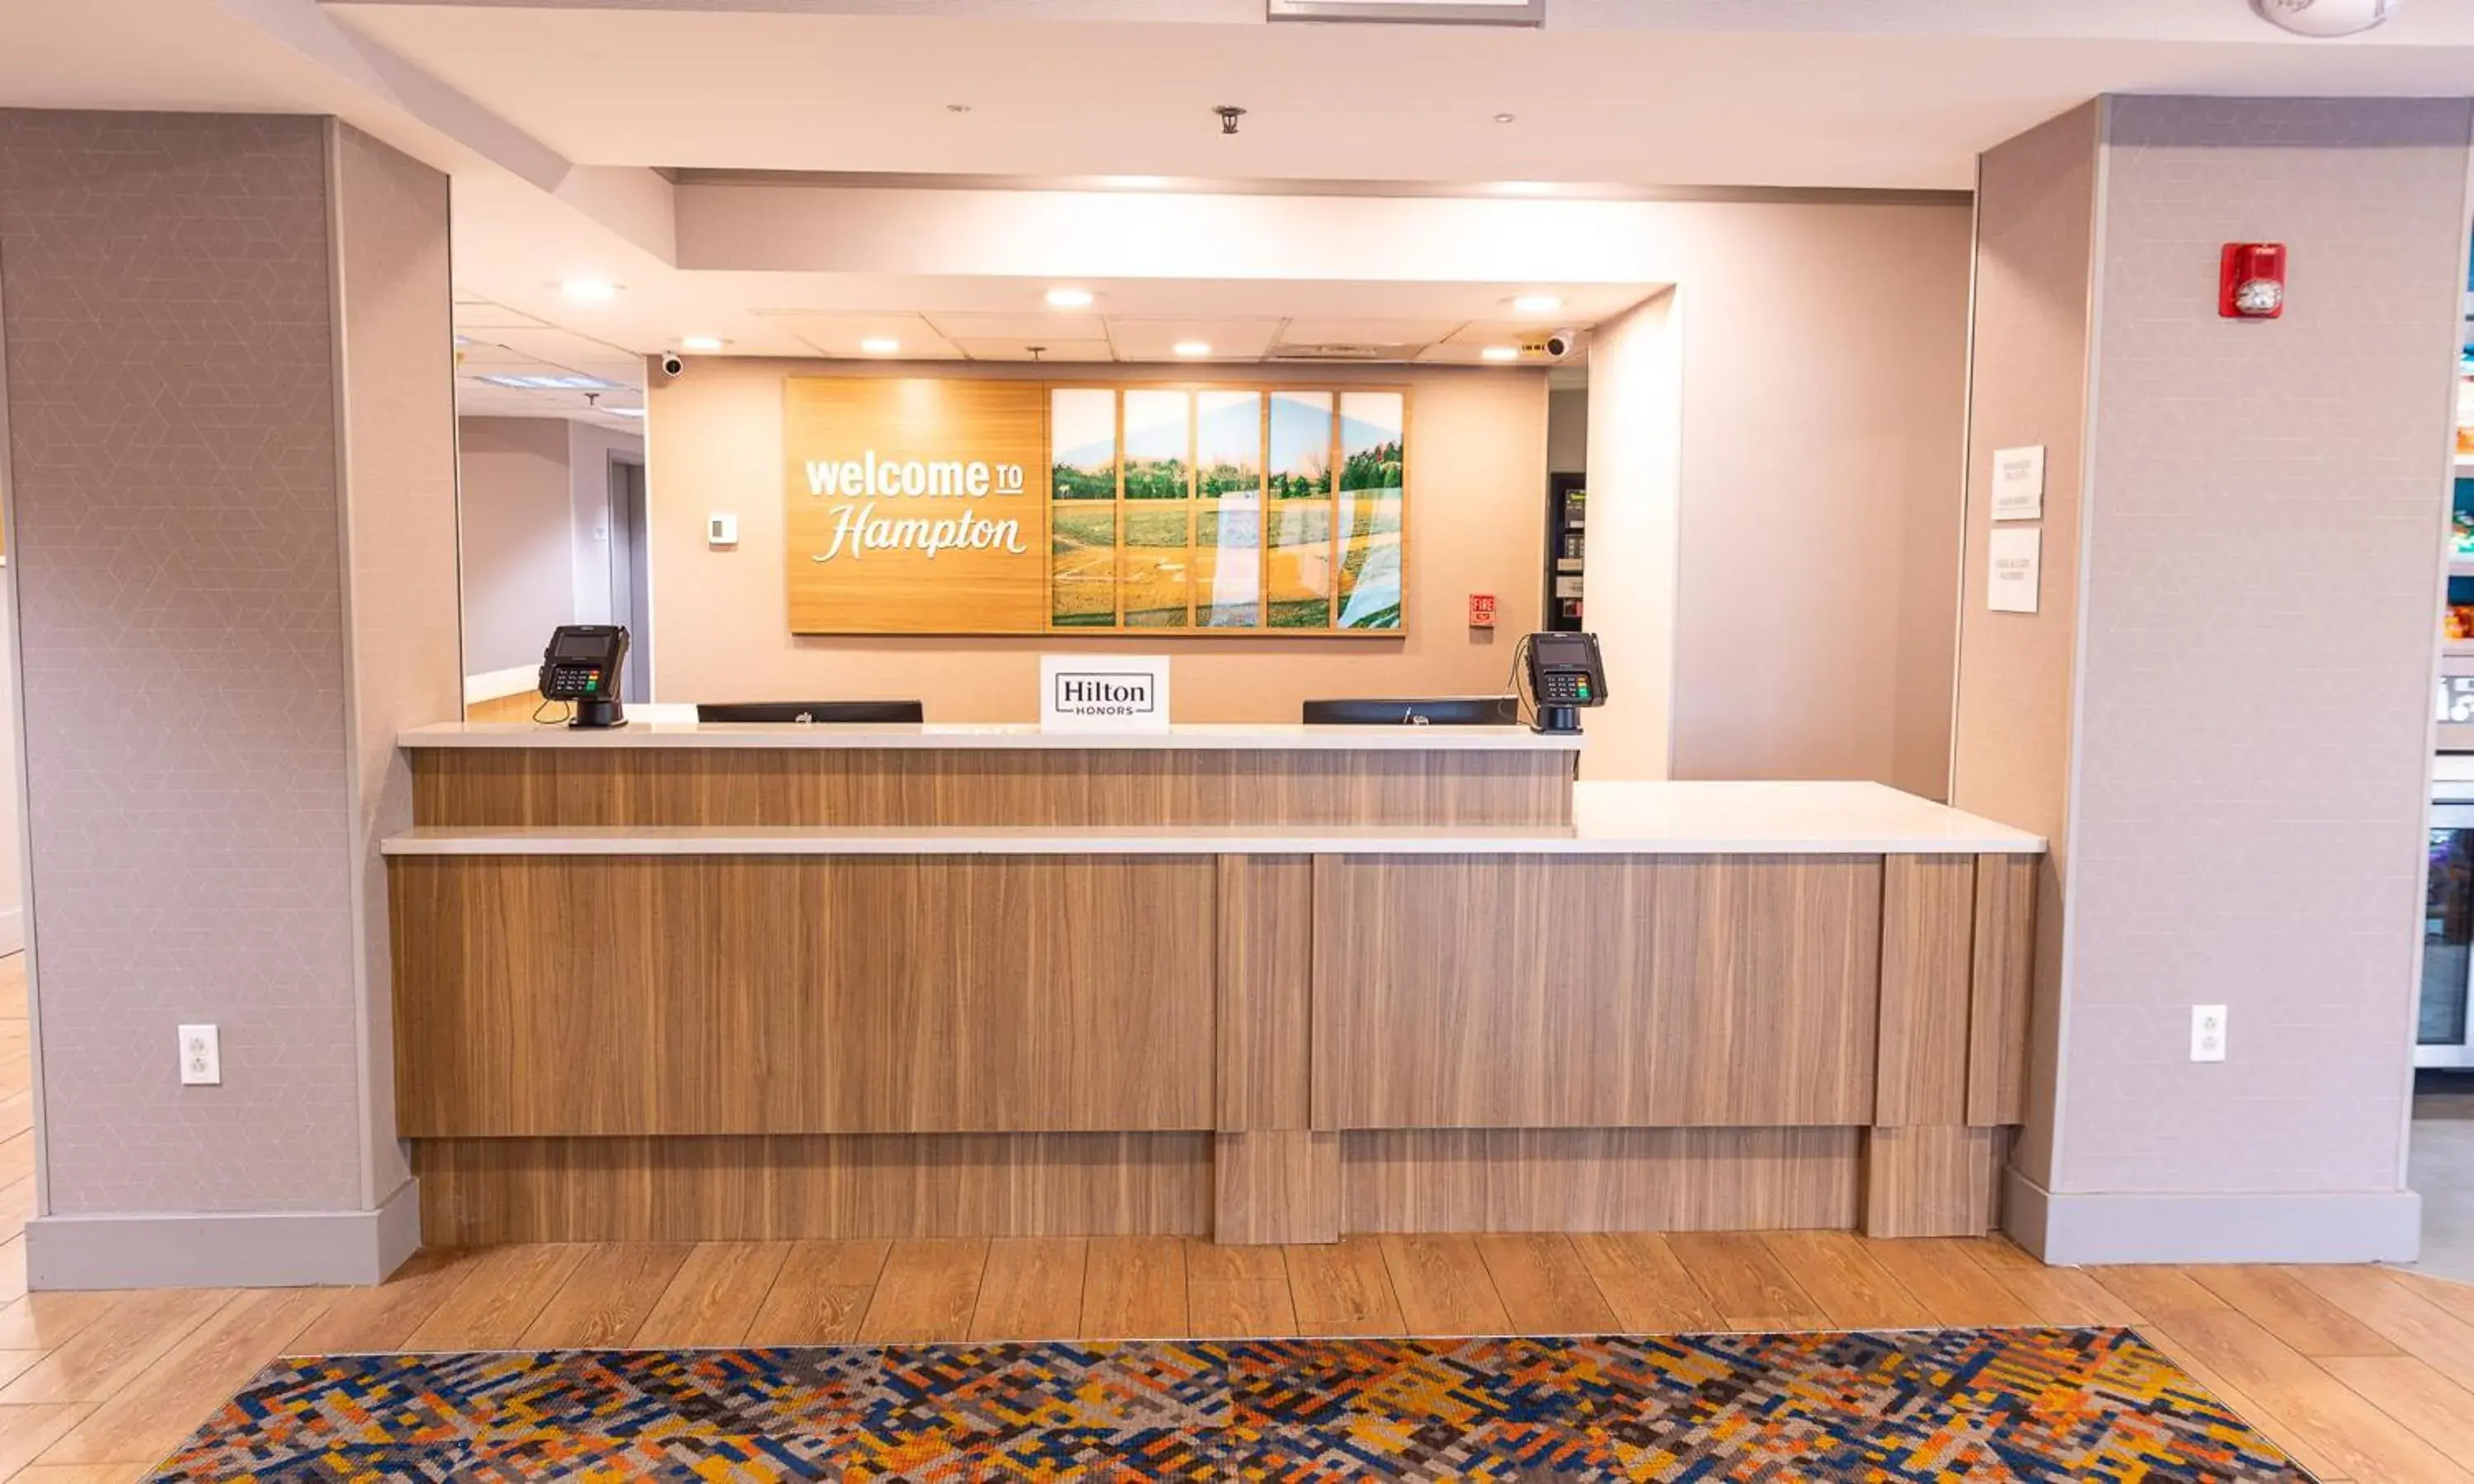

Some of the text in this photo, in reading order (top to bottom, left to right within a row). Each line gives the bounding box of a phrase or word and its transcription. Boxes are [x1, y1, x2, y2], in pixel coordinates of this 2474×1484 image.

[806, 450, 1023, 496] welcome TO
[812, 501, 1027, 562] Hampton
[1065, 681, 1145, 702] Hilton
[1076, 707, 1134, 716] HONORS
